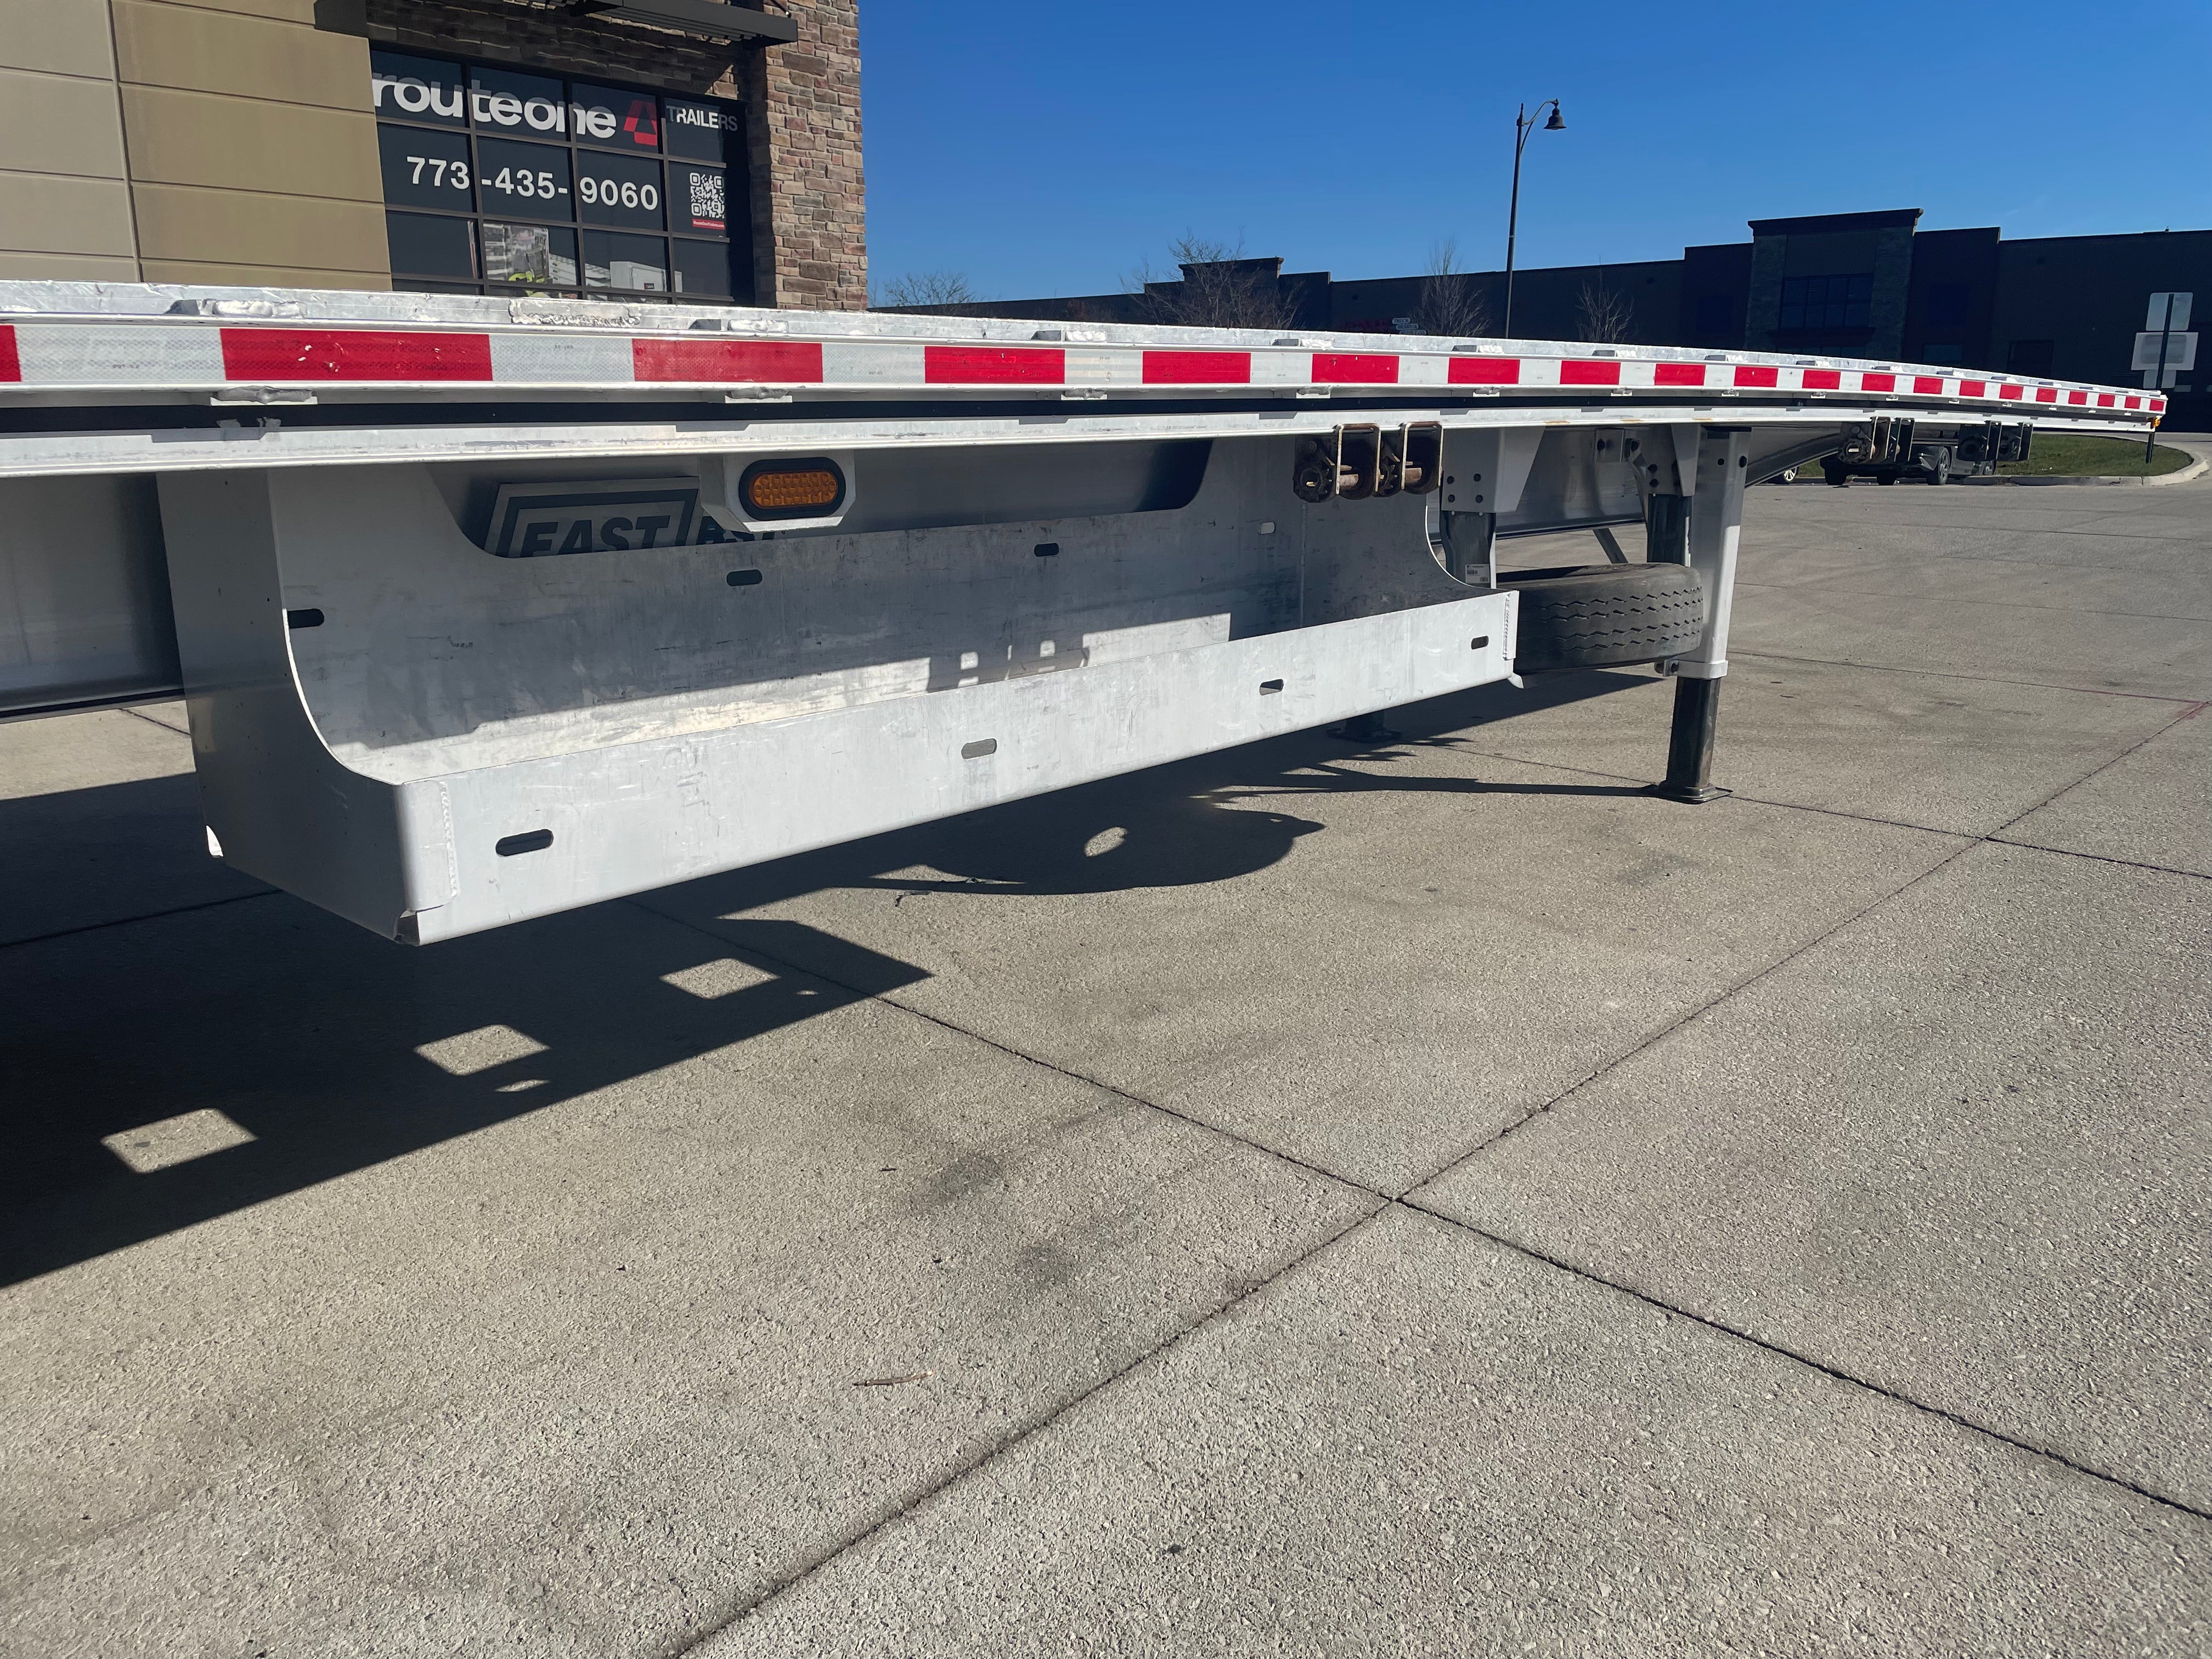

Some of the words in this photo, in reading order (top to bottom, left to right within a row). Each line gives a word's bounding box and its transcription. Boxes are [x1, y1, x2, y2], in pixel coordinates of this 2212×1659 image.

[372, 72, 617, 138] routeone
[665, 105, 738, 131] TRAILERS
[520, 515, 670, 557] EAST
